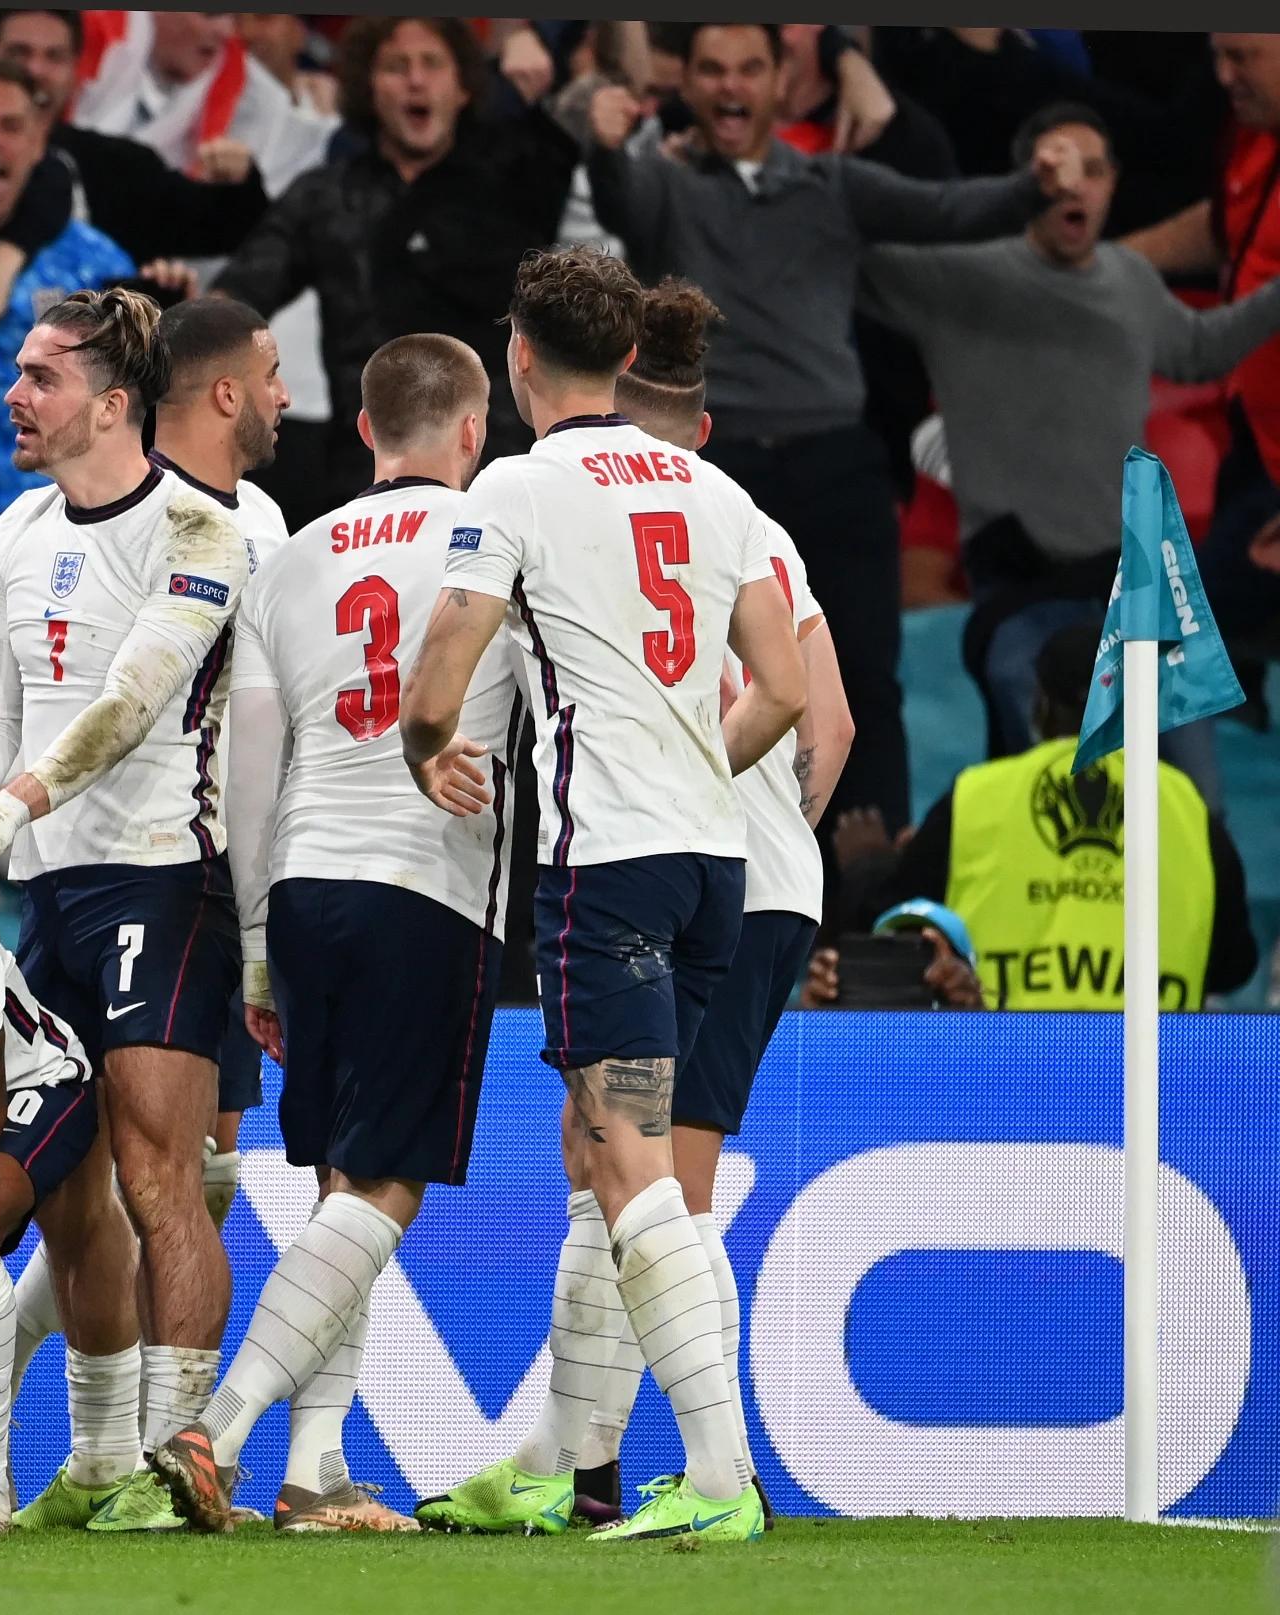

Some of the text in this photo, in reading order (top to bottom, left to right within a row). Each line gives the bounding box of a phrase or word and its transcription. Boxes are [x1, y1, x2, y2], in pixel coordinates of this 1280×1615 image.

[582, 451, 693, 486] STONES
[330, 510, 428, 554] SHAW
[189, 582, 228, 601] RESPECT
[629, 511, 695, 687] 5
[1161, 539, 1200, 637] SIGN
[46, 620, 68, 682] 7
[335, 574, 400, 741] 3
[116, 924, 144, 992] 7
